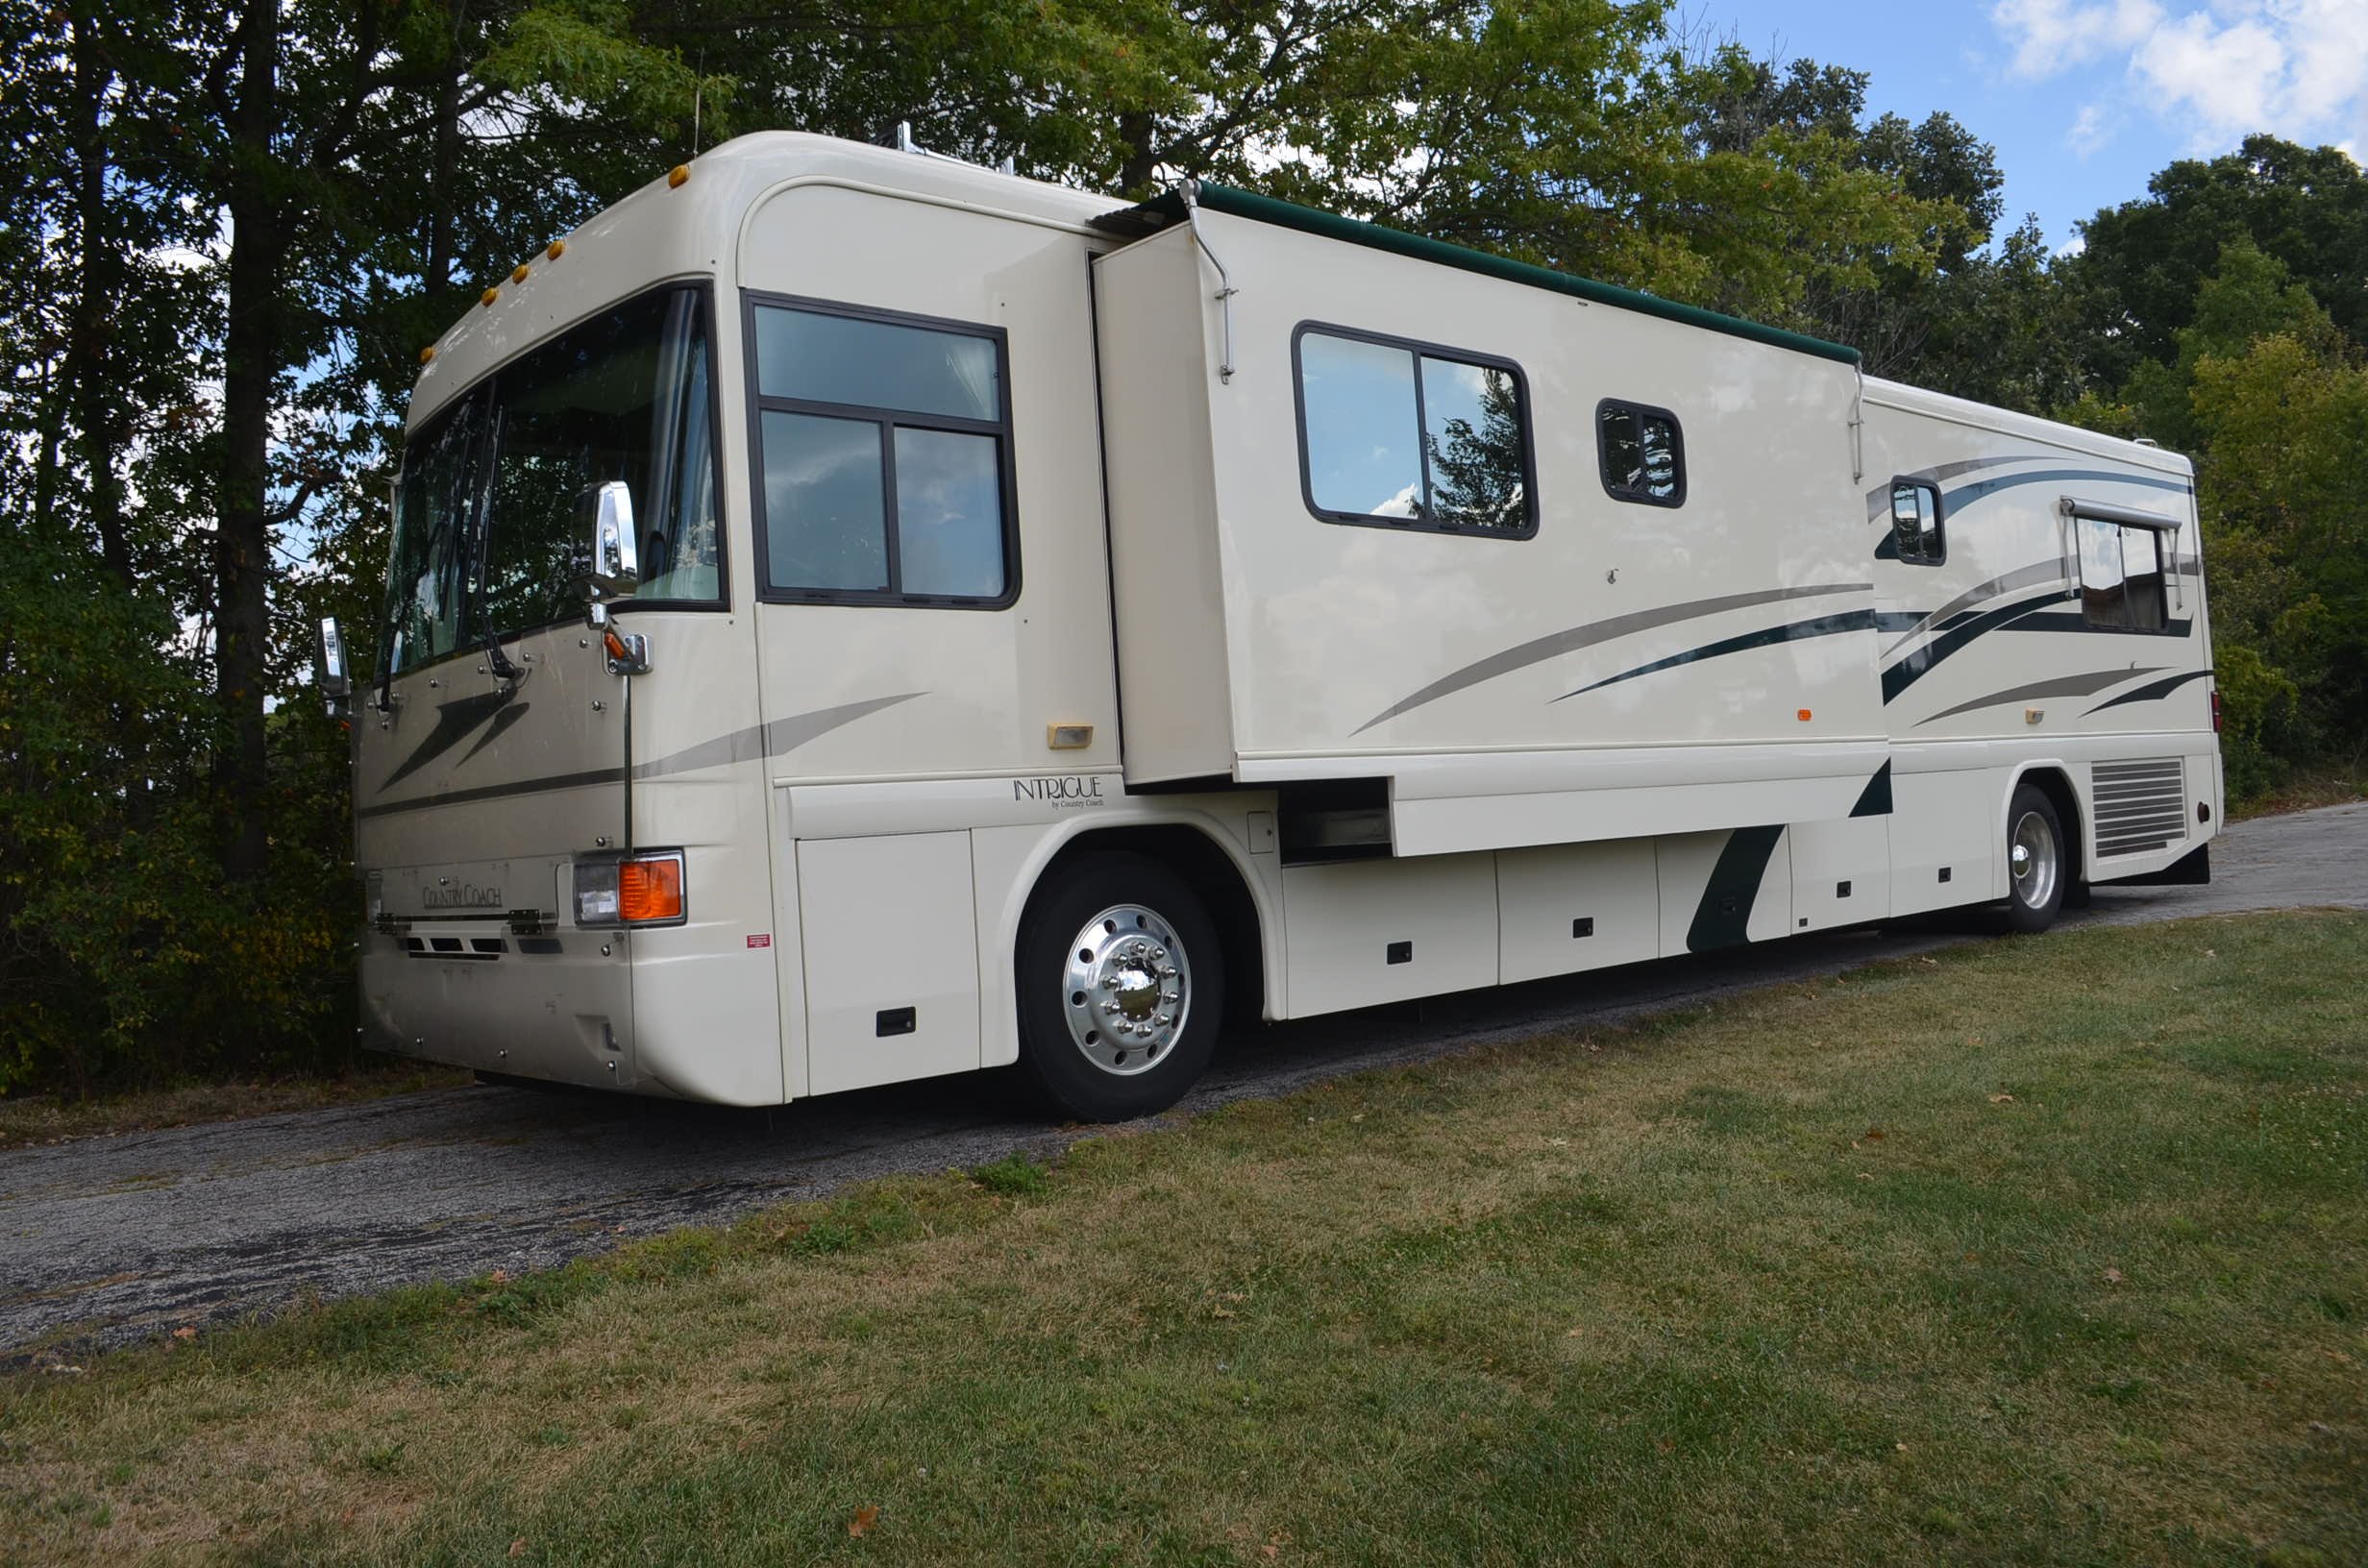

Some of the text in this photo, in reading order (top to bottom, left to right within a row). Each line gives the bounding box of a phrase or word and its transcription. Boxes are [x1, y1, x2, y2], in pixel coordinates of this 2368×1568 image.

[1013, 776, 1103, 801] INTRIGUE
[1051, 798, 1104, 810] by Country Coach
[423, 884, 503, 909] COUNTRY COACH
